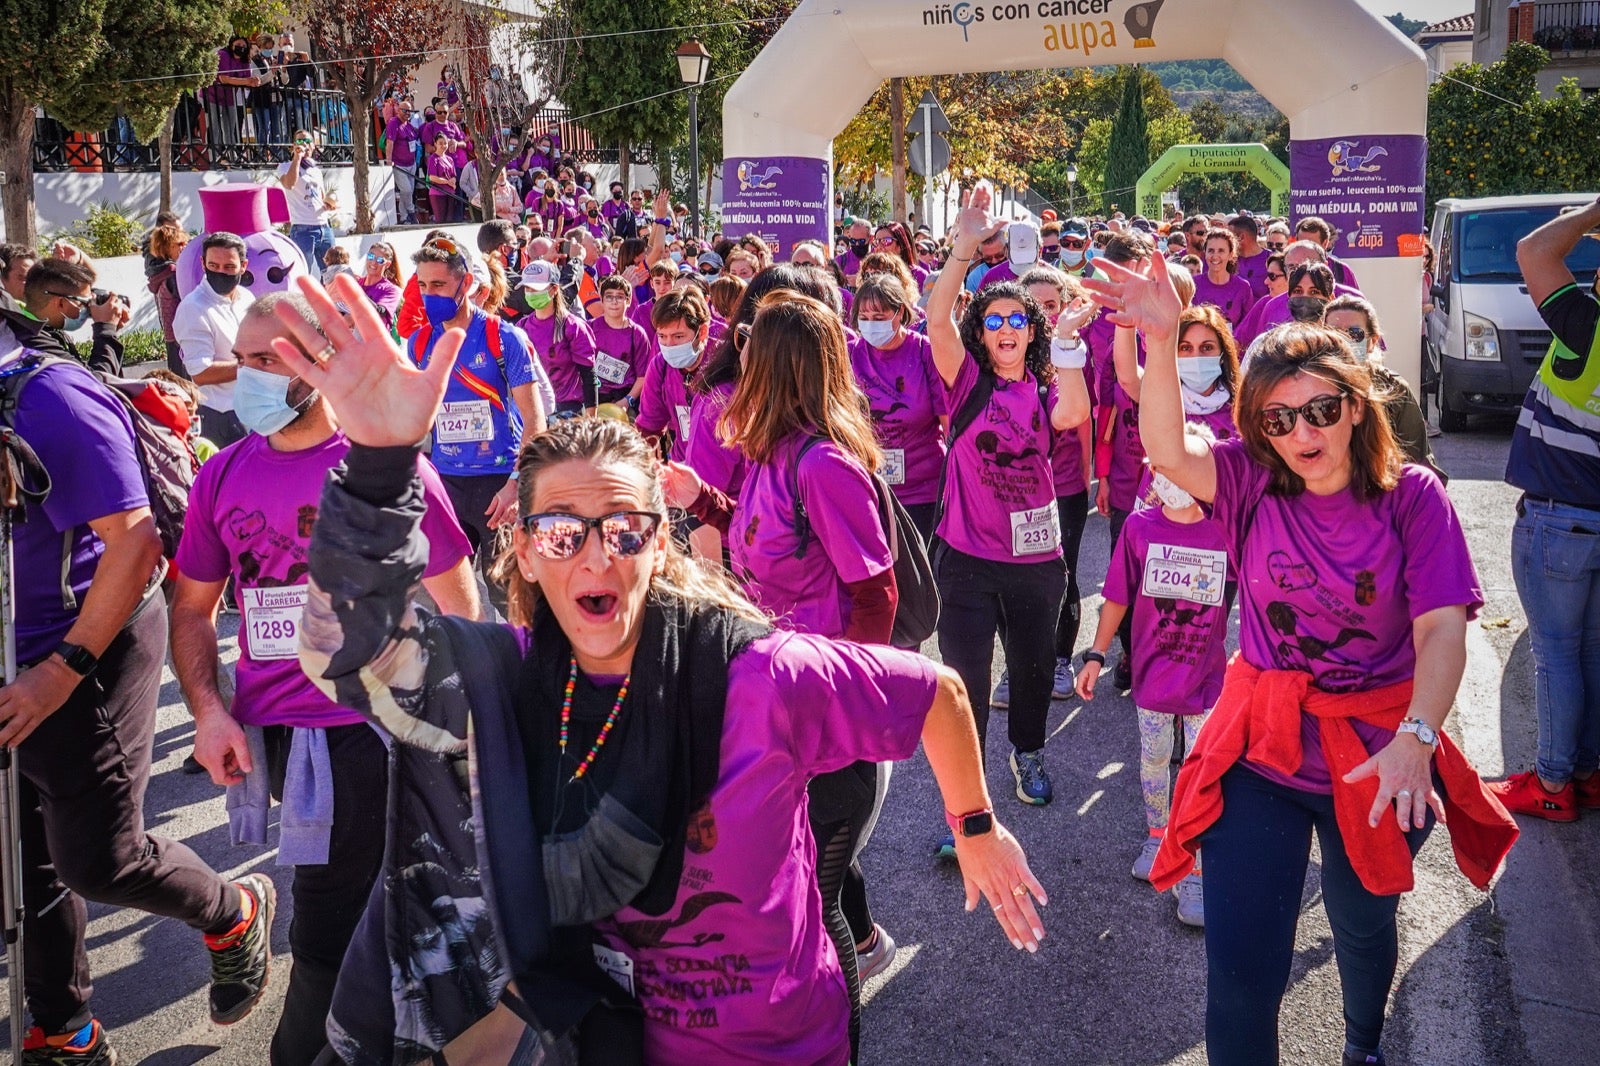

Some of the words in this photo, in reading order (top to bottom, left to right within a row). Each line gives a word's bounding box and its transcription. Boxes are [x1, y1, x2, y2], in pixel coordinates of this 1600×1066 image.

[992, 4, 1030, 22] con
[1043, 20, 1117, 56] aupa
[1189, 148, 1247, 159] Diputación
[1189, 158, 1200, 168] de
[1203, 157, 1246, 168] Granada
[1308, 189, 1318, 197] un
[1318, 186, 1345, 197] sueño,
[1347, 185, 1385, 195] leucemia
[1386, 185, 1406, 193] 100%
[750, 200, 780, 208] leucemia
[782, 200, 801, 208] 100%
[1295, 203, 1317, 215] DONA
[1318, 201, 1365, 215] MÉDULA,
[1368, 202, 1398, 213] DONA
[1400, 201, 1418, 212] VIDA
[732, 212, 765, 225] MÉDULA,
[767, 214, 793, 224] DONA
[795, 214, 816, 225] VIDA
[1358, 234, 1383, 250] aupa
[443, 403, 451, 413] V
[441, 419, 469, 432] 1247
[1024, 511, 1033, 523] V
[1024, 529, 1049, 543] 233
[1162, 546, 1173, 559] V
[1171, 554, 1202, 564] CARRERA
[1151, 568, 1191, 587] 1204
[254, 589, 264, 607] V
[264, 597, 302, 607] CARRERA
[252, 619, 295, 640] 1289
[686, 1007, 720, 1028] 2021
